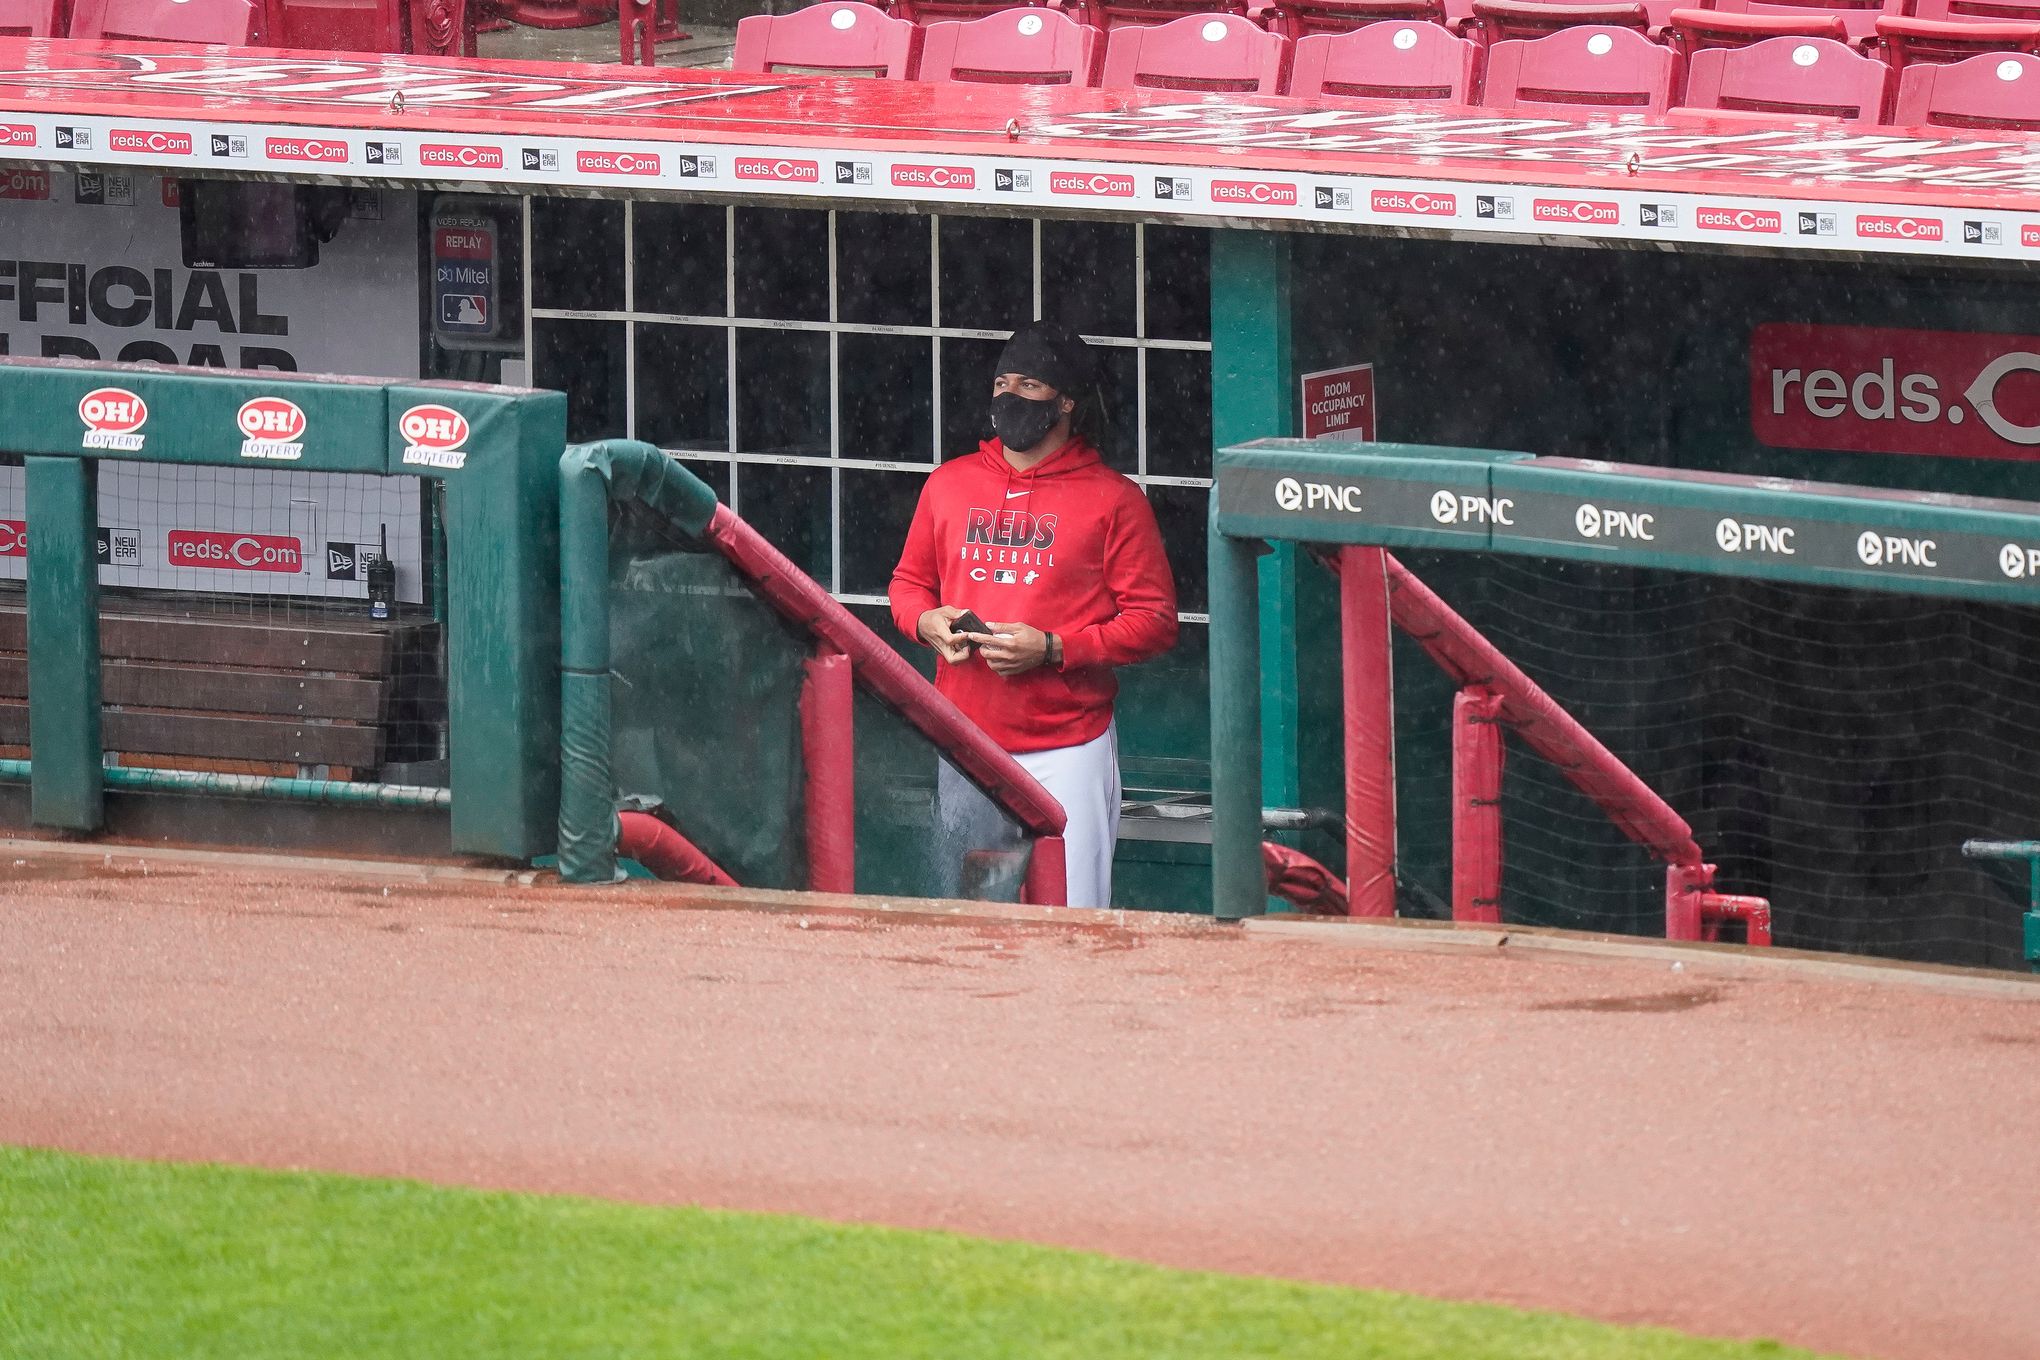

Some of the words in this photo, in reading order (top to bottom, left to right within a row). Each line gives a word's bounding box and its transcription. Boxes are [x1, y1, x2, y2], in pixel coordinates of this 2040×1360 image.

[1027, 20, 1035, 30] 2
[109, 176, 130, 188] NEW
[109, 187, 131, 199] ERA
[438, 218, 457, 226] VIDEO
[460, 218, 486, 227] REPLAY
[446, 235, 482, 249] REPLAY
[456, 267, 489, 285] Mitel
[1324, 381, 1351, 398] ROOM
[84, 398, 139, 423] OH!
[1312, 394, 1366, 415] OCCUPANCY
[242, 408, 298, 432] OH!
[405, 415, 462, 440] OH!
[1325, 412, 1351, 430] LIMIT
[85, 434, 141, 449] LOTTERY
[244, 443, 300, 457] LOTTERY
[406, 449, 462, 466] LOTTERY
[1304, 483, 1362, 512] PNC
[1460, 496, 1514, 526] PNC
[965, 507, 1058, 550] REDS
[1602, 509, 1654, 540] PNC
[115, 536, 137, 548] NEW
[1743, 523, 1795, 554] PNC
[115, 547, 137, 559] ERA
[961, 546, 1054, 567] BASEBALL
[1885, 536, 1937, 567] PNC
